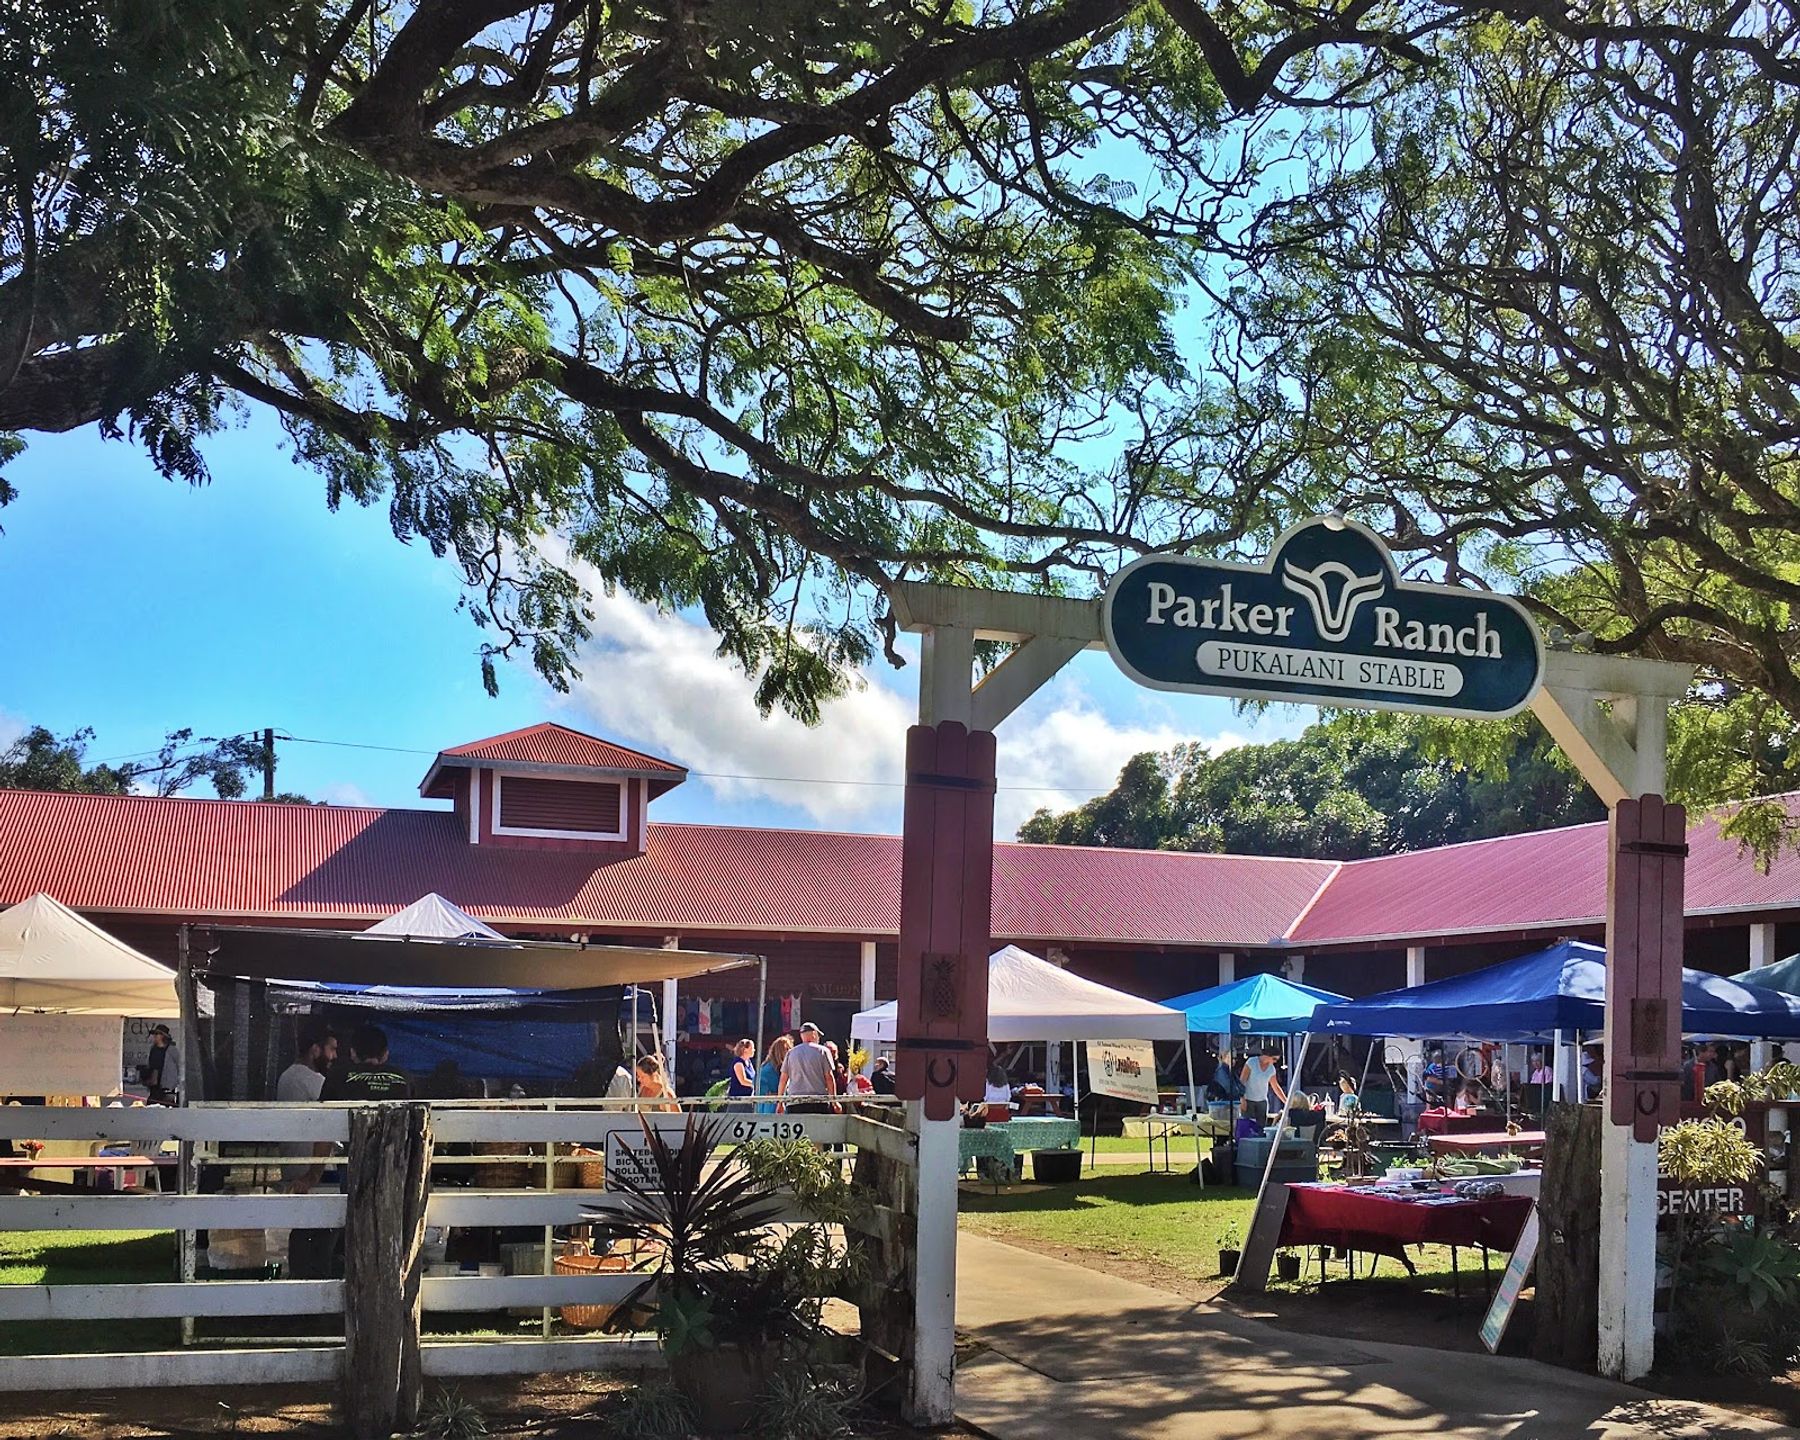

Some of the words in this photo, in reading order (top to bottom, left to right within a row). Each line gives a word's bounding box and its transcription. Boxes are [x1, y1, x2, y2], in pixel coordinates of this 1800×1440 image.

[1146, 582, 1294, 637] Parker
[1374, 607, 1502, 659] Ranch
[1217, 648, 1346, 681] PUKALANI
[1359, 662, 1446, 691] STABLE
[733, 1121, 804, 1140] 67-139
[1657, 1188, 1744, 1216] CENTER
